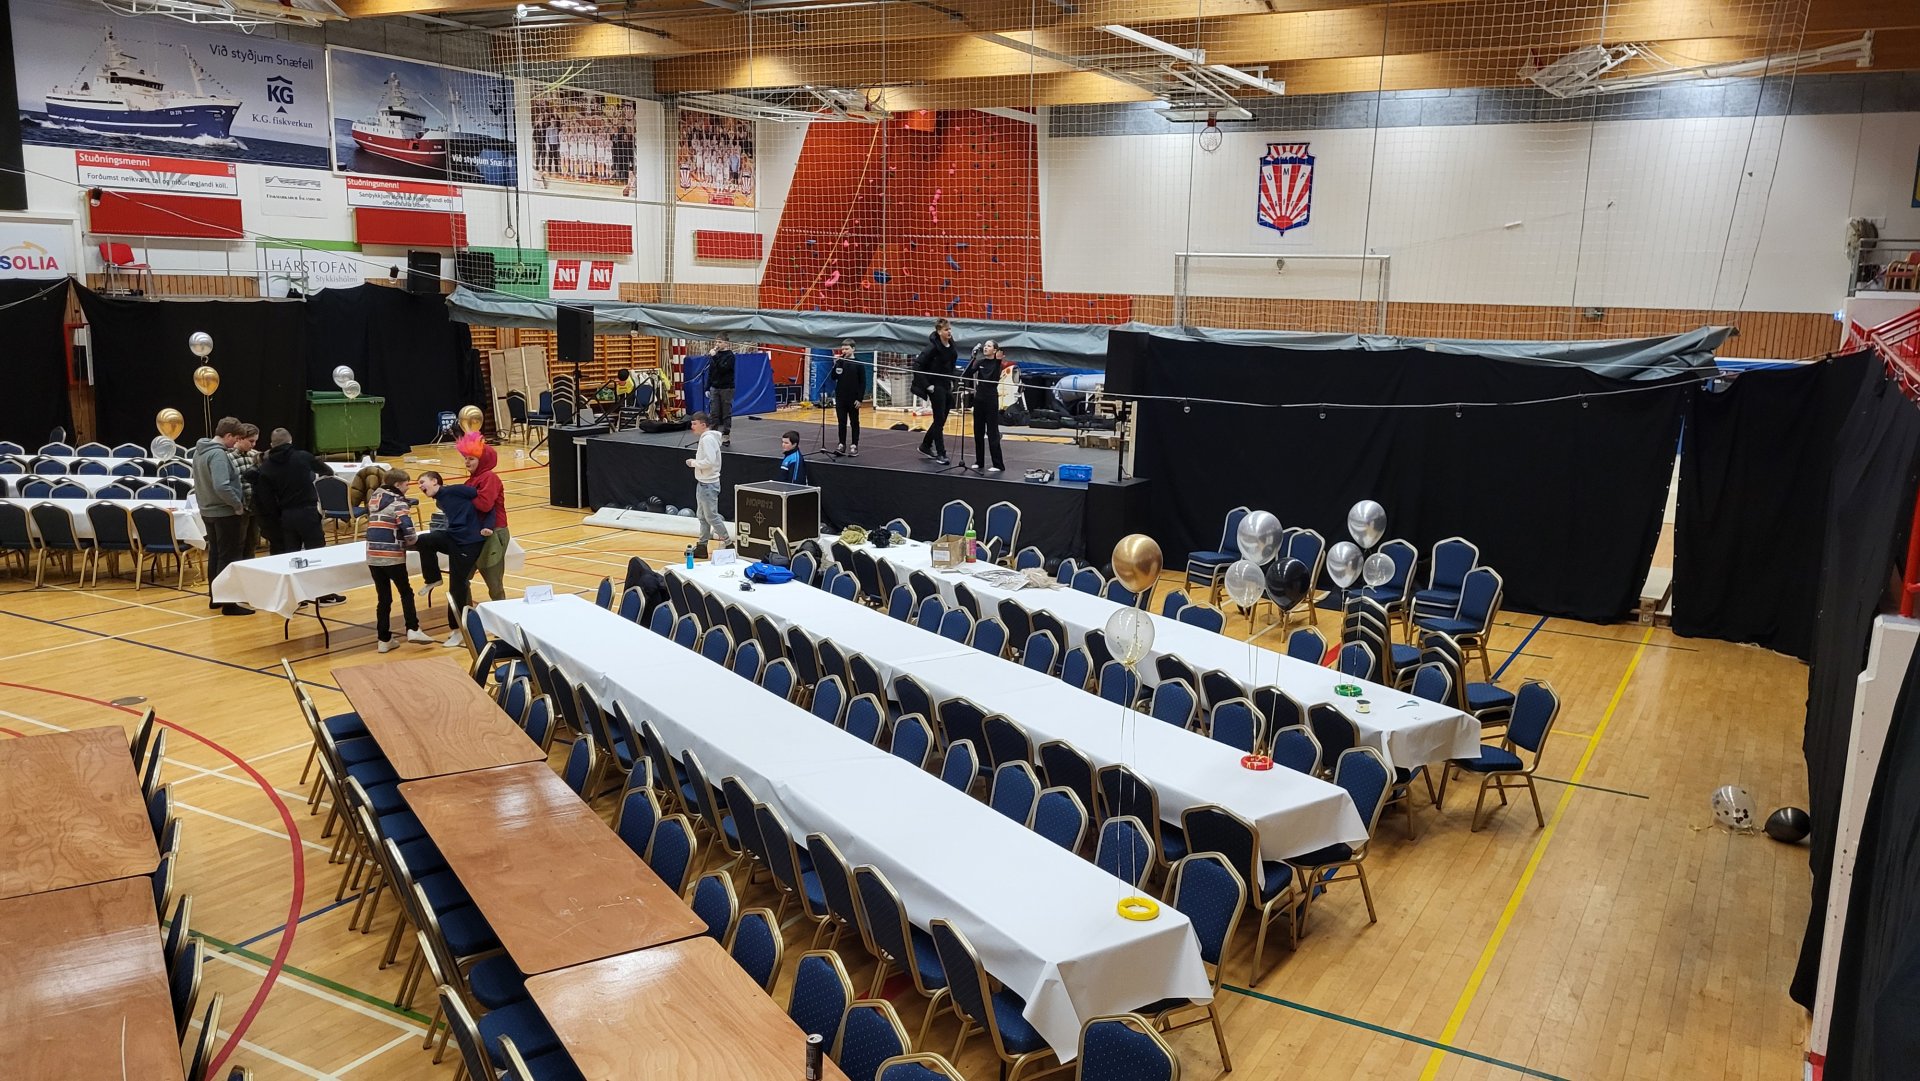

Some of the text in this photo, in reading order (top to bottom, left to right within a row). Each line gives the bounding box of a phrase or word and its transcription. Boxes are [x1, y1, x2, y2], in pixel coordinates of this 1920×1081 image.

[209, 43, 314, 70] Við styðjum Snæfell
[267, 84, 294, 104] KG
[252, 113, 313, 129] K.G. fiskverkun
[79, 152, 150, 167] Stuðningsmenn!
[86, 172, 119, 181] Forðumst
[162, 178, 170, 186] og
[347, 178, 400, 189] Stuðningsmenn!
[0, 255, 59, 270] SOLIA
[271, 256, 357, 274] HÁRSTOFAN
[315, 274, 358, 286] Stykkishólmi
[558, 267, 577, 283] N1
[593, 267, 611, 283] N1
